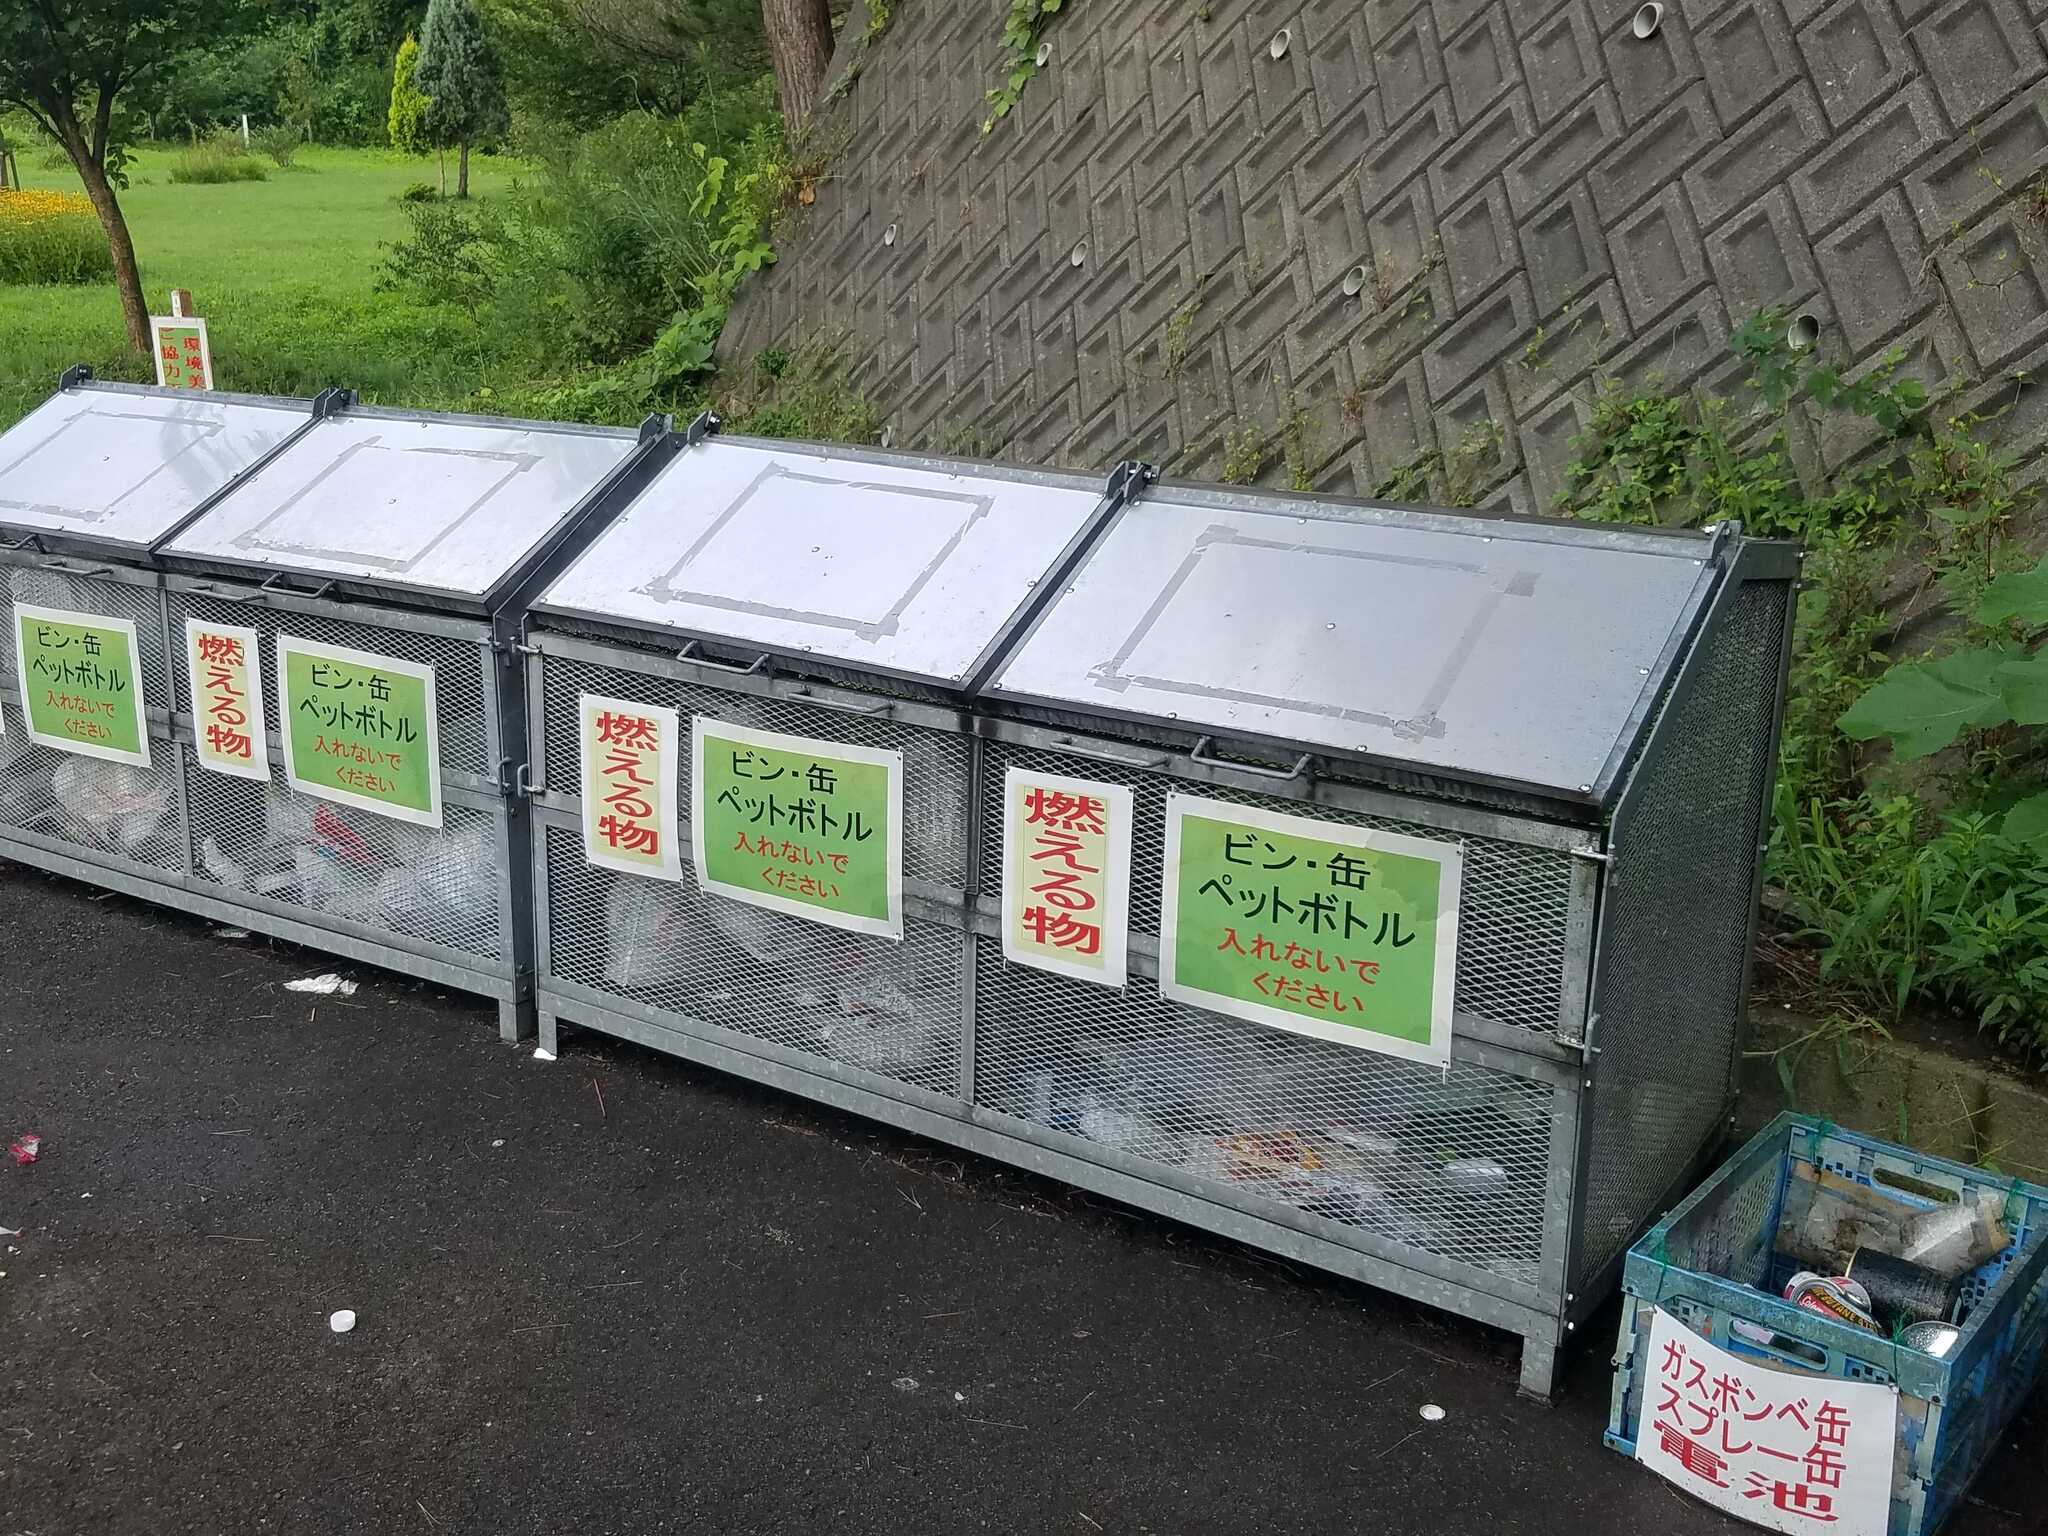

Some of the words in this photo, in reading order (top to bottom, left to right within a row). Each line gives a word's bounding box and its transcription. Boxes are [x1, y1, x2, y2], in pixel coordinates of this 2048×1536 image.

[38, 626, 102, 656] ビン・缶
[33, 658, 126, 693] ペットボトル
[197, 634, 252, 758] 燃える物
[311, 664, 392, 702] ビン・缶
[46, 690, 115, 717] 入れないで
[299, 695, 418, 744] ペットボトル
[64, 718, 112, 740] ください
[314, 735, 402, 770] 入れないで
[732, 750, 838, 794] ビン・缶
[336, 767, 396, 795] ください
[596, 711, 658, 856] 燃える物
[717, 785, 873, 842] ペットボトル
[734, 831, 849, 874] 入れないで
[1023, 788, 1105, 955] 燃える物
[1224, 833, 1372, 891] ビン・缶
[761, 867, 839, 898] ください
[1198, 874, 1416, 949] ペットボトル
[1216, 927, 1381, 985] 入れないで
[1250, 971, 1365, 1012] ください
[1660, 1339, 1851, 1447] ガスボンベ缶
[1656, 1382, 1847, 1489] スプレー缶
[1653, 1419, 1839, 1522] 電池
